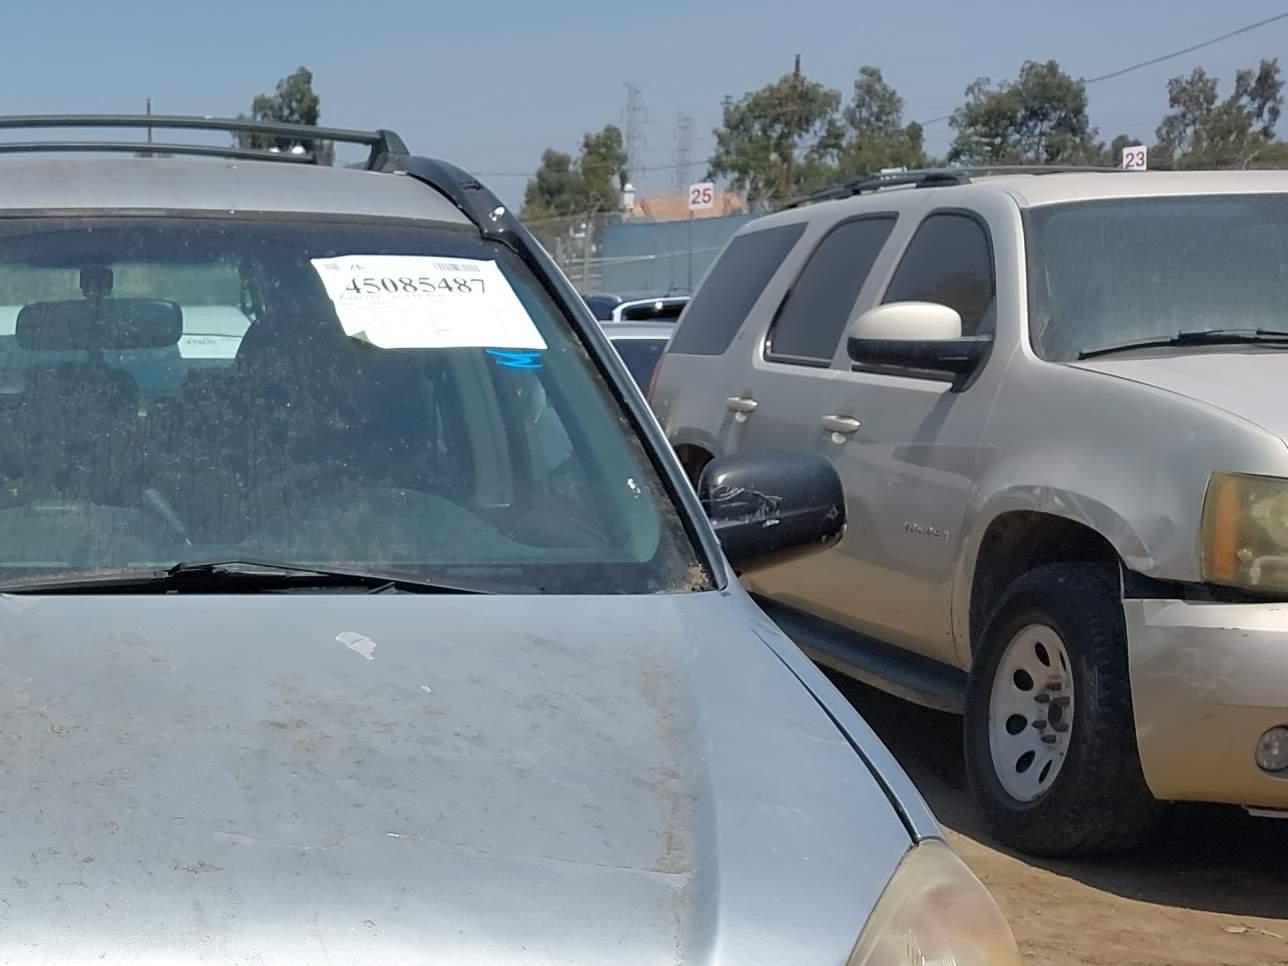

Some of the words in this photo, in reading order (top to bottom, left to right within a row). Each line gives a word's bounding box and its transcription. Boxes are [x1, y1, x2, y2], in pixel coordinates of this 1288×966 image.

[1125, 151, 1145, 168] 23
[691, 188, 712, 204] 25
[345, 276, 486, 294] 45085487
